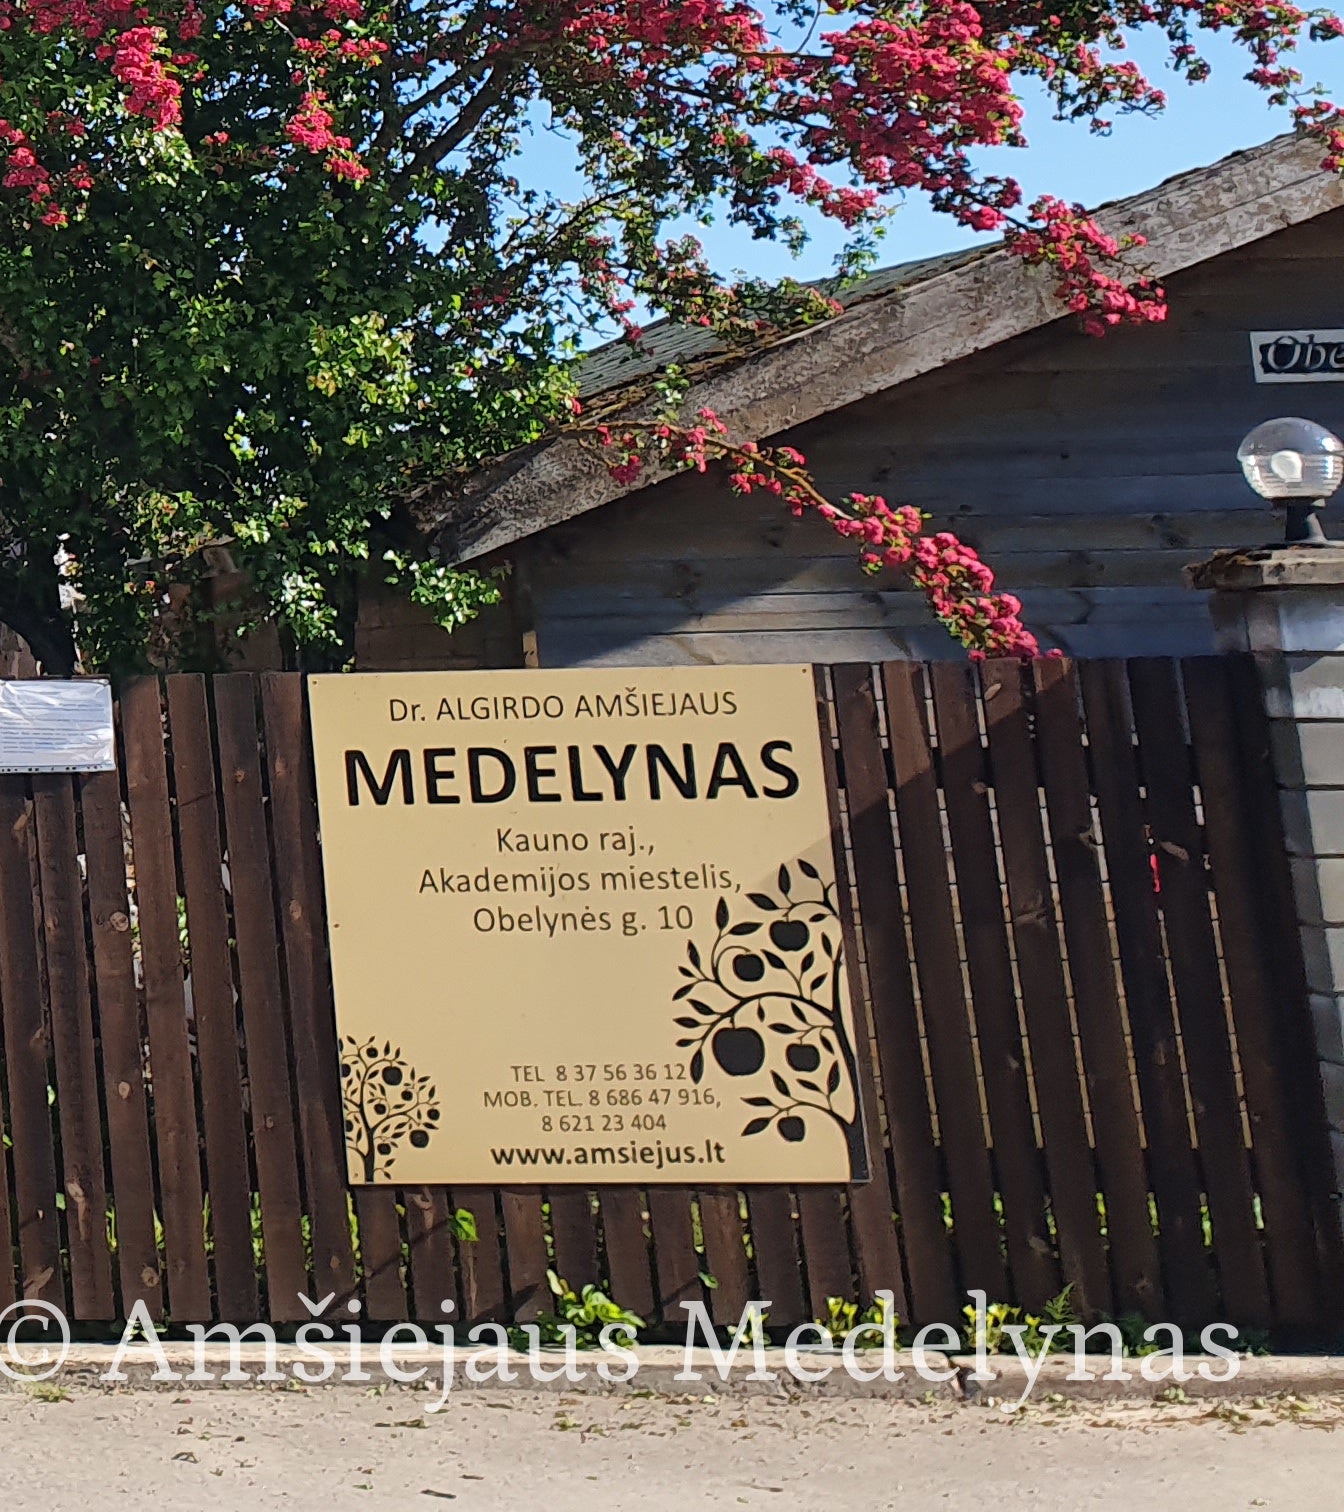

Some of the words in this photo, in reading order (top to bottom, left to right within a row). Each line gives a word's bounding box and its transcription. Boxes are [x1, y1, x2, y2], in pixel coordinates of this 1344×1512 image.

[389, 699, 426, 722] Dr.
[436, 695, 563, 721] ALGIRDO
[574, 686, 739, 719] AMŠIEJAUS
[344, 740, 801, 807] MEDELYNAS
[496, 828, 589, 853] Kauno
[599, 826, 655, 857] raj.,
[418, 867, 591, 898] Akademijos
[600, 864, 742, 894] miestelis,
[473, 905, 612, 938] Obelynės
[622, 911, 647, 937] g.
[658, 905, 694, 930] 10
[556, 1065, 568, 1082] 8
[573, 1065, 596, 1082] 37
[603, 1064, 627, 1082] 56
[633, 1064, 657, 1081] 36
[663, 1063, 687, 1081] 12
[483, 1091, 539, 1108] MOB.
[588, 1090, 601, 1107] 8
[606, 1089, 643, 1106] 686
[648, 1089, 672, 1106] 47
[677, 1088, 722, 1108] 916,
[541, 1115, 553, 1132] 8
[559, 1115, 595, 1132] 621
[601, 1114, 625, 1131] 23
[630, 1113, 667, 1131] 404
[490, 1139, 726, 1169] www.amsiejus.lt
